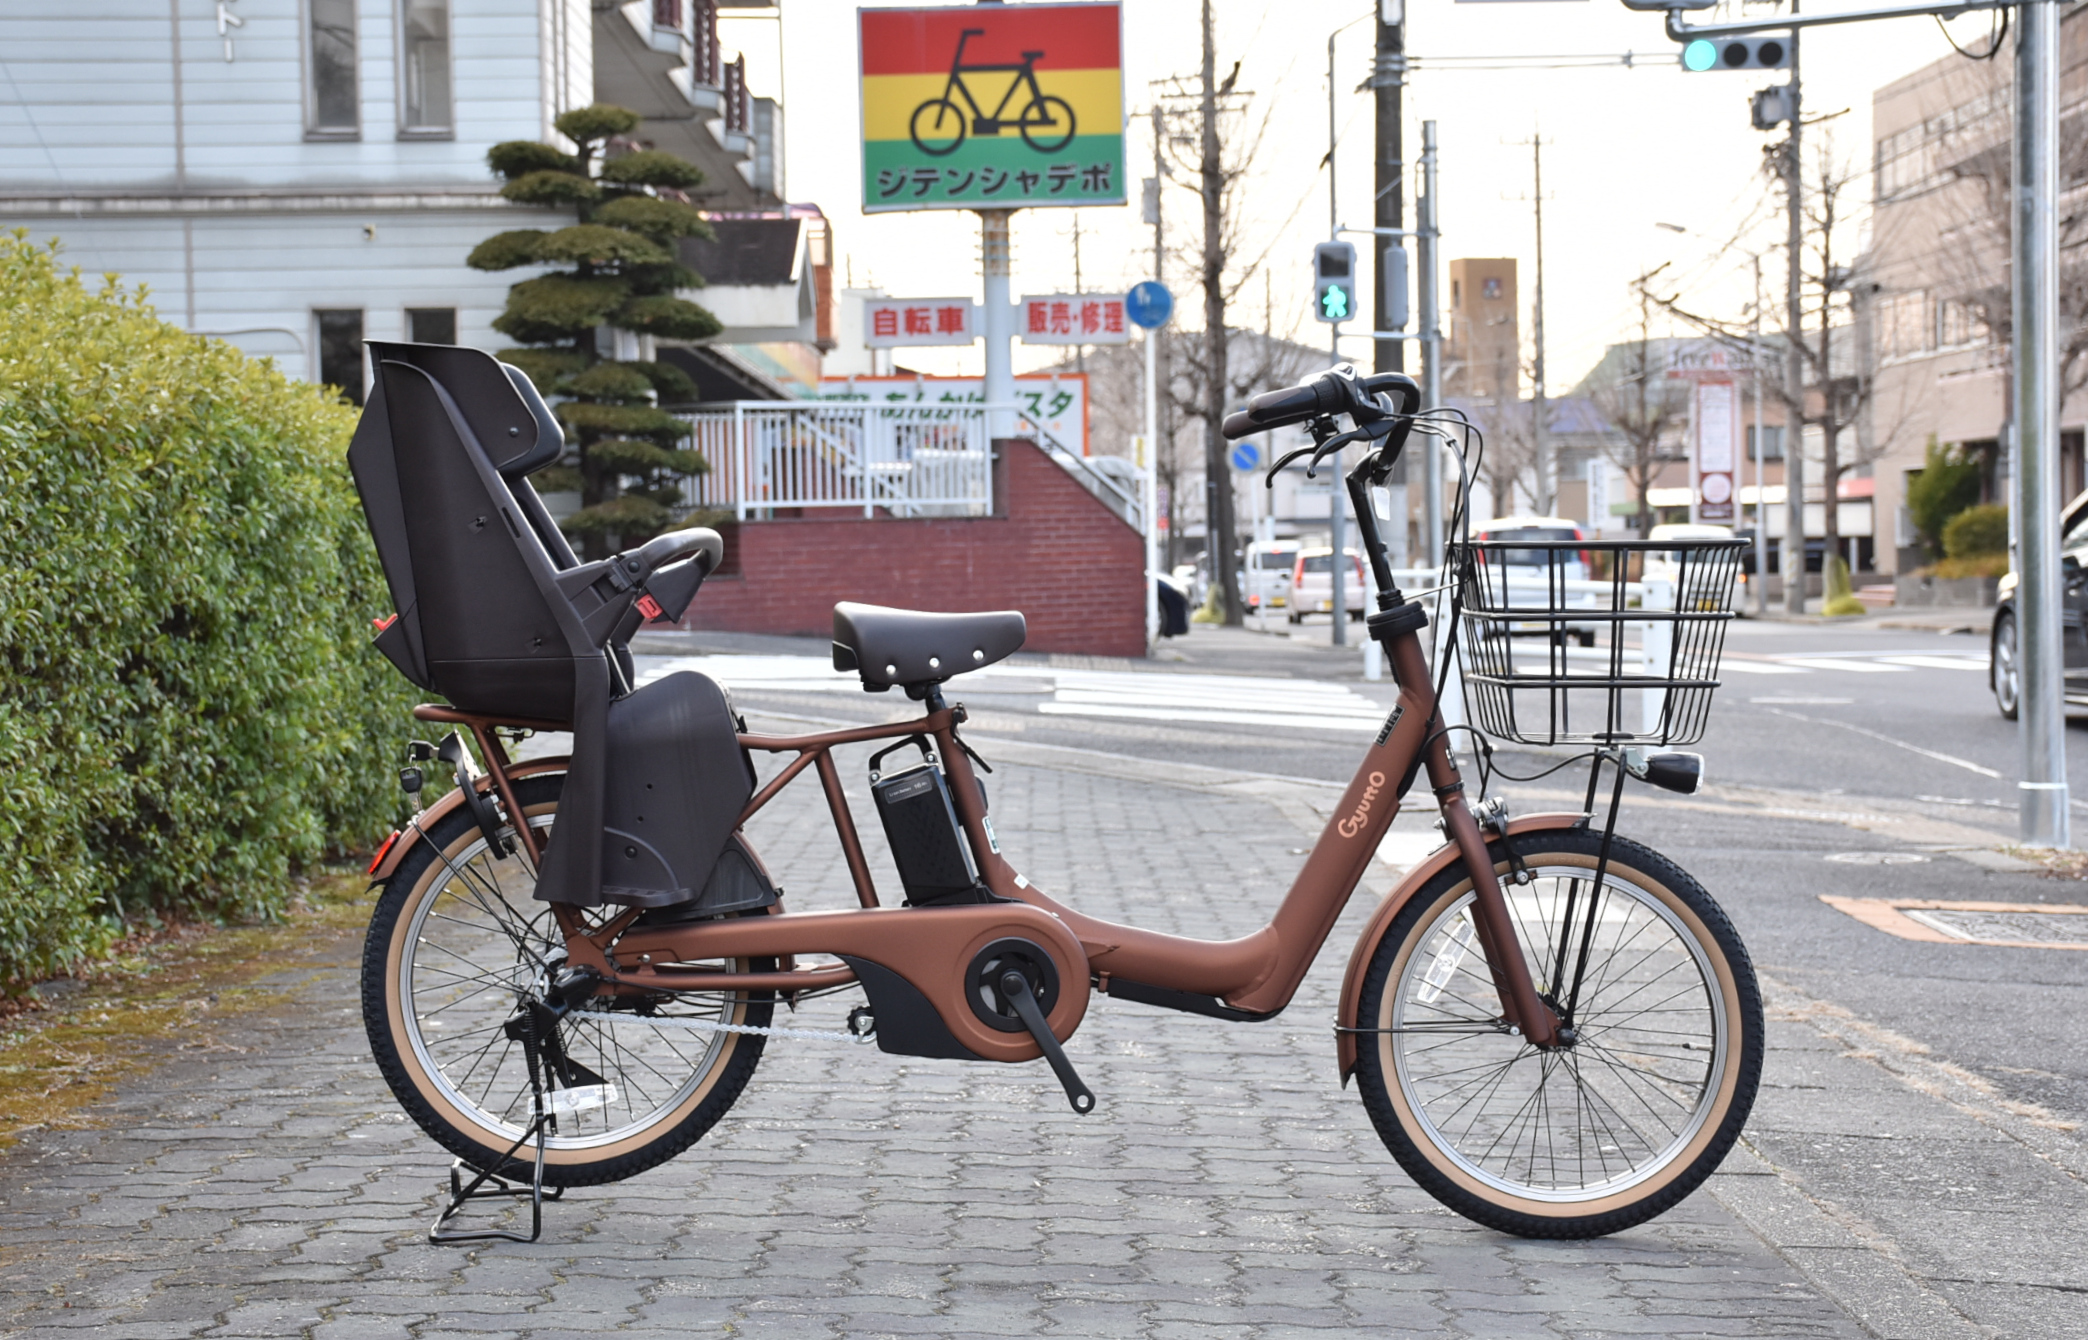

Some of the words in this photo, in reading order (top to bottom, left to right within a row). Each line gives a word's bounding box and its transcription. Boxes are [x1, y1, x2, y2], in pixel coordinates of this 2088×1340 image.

[877, 162, 1112, 199] ジテンシャデポ
[873, 306, 965, 337] 自転車
[1027, 300, 1125, 335] 販売・修理
